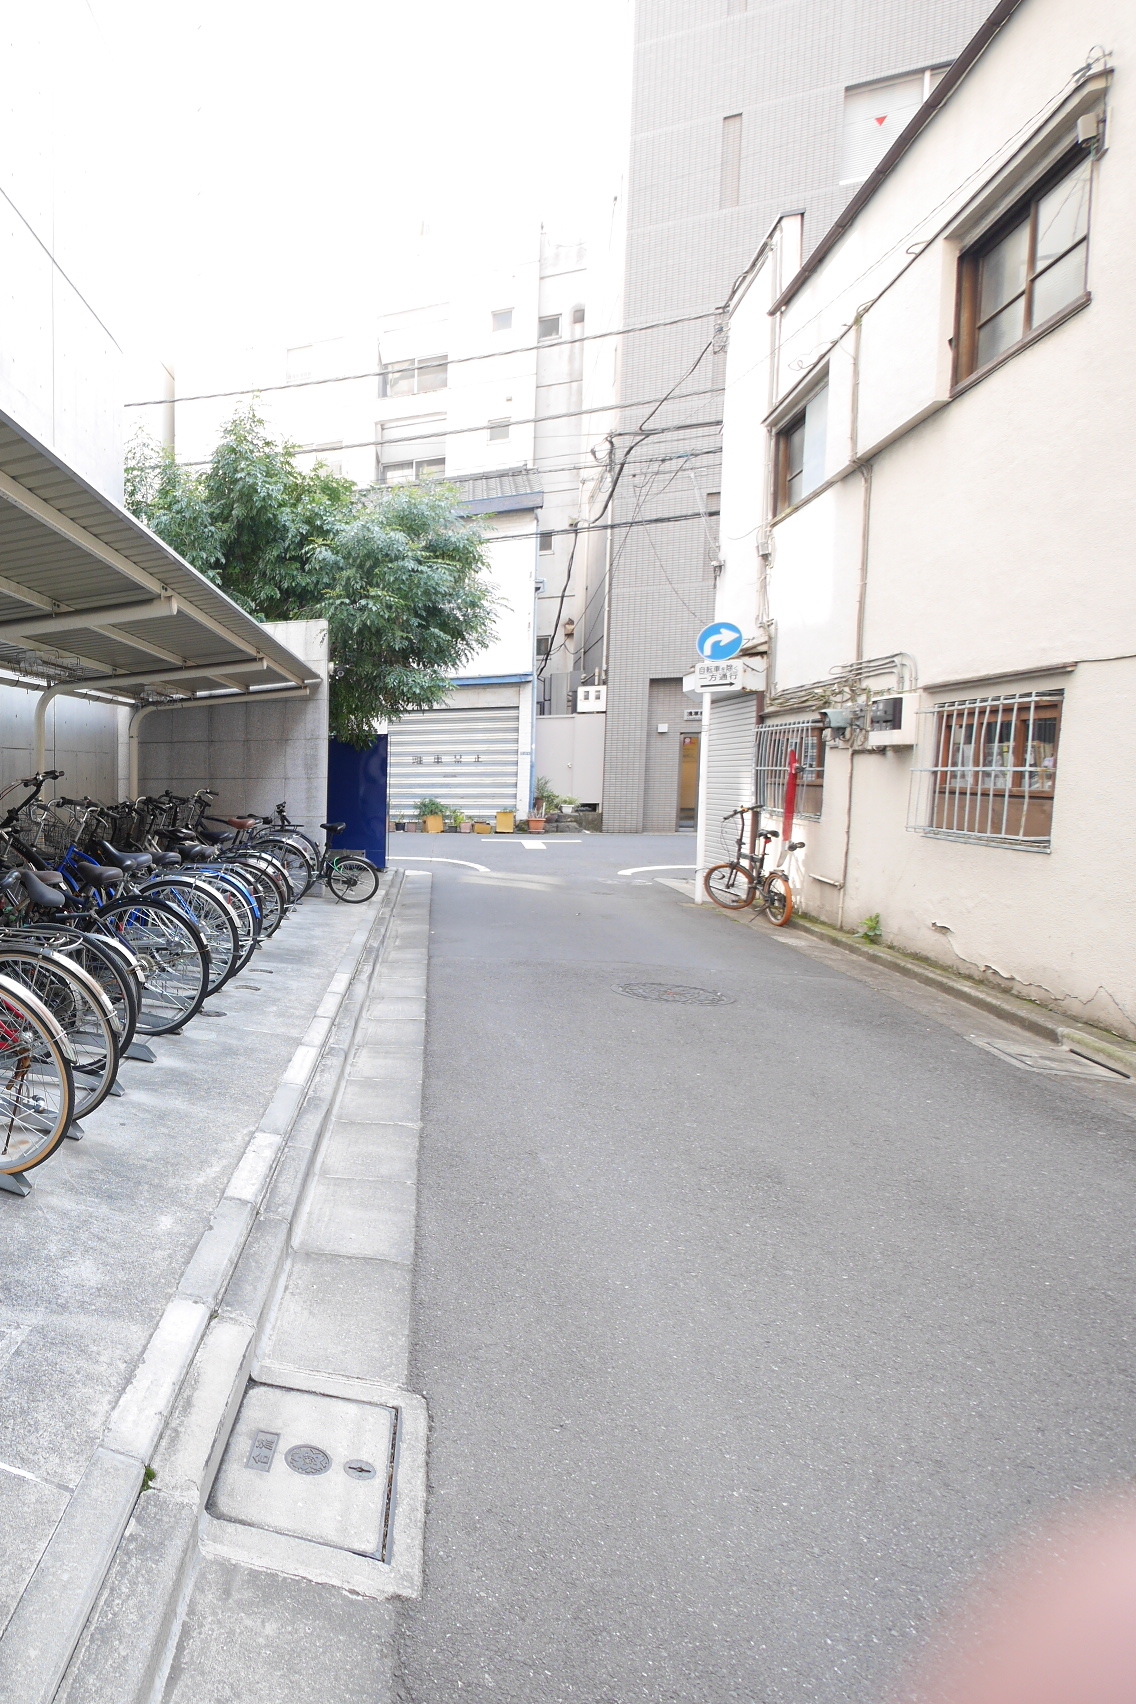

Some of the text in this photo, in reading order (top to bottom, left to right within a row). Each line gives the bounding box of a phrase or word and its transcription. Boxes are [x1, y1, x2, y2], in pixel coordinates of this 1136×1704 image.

[698, 664, 738, 675] 自転車を除く
[698, 673, 738, 682] 一方通行
